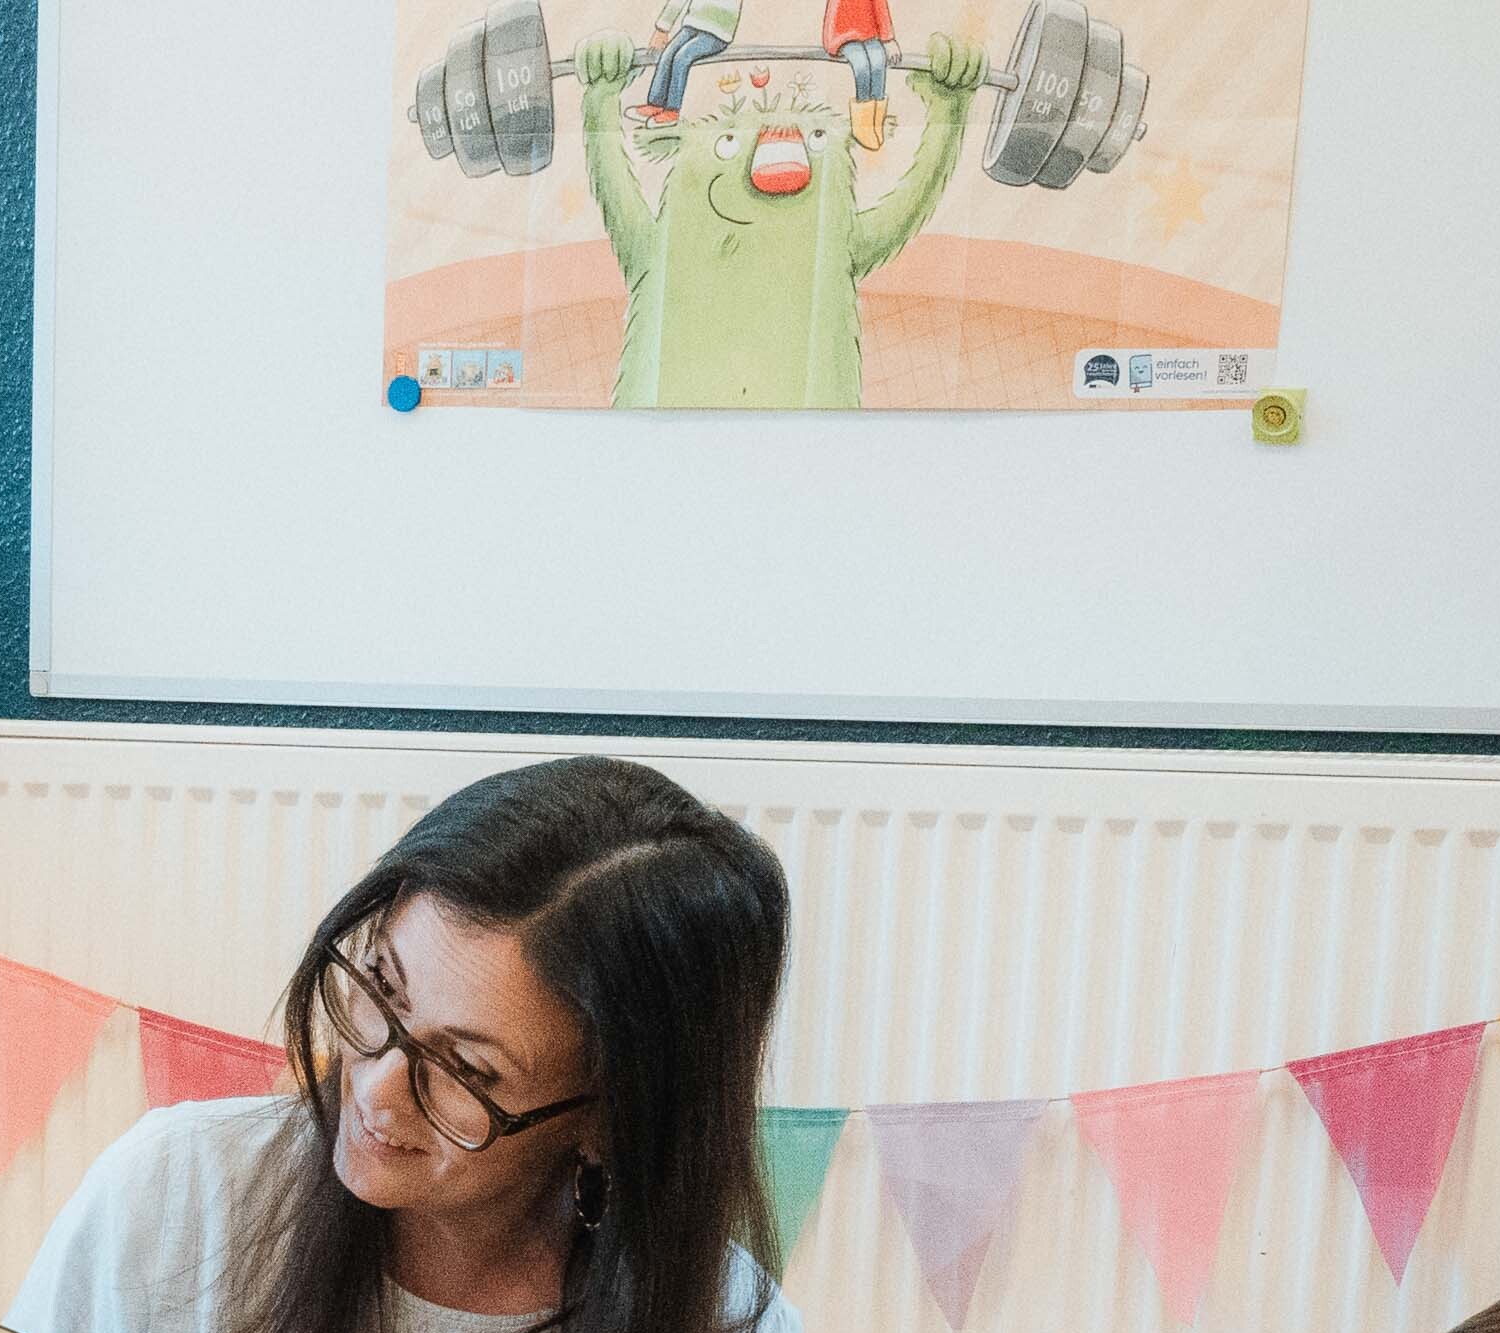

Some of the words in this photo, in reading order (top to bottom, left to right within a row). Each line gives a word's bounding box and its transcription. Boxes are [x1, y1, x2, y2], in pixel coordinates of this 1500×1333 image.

[497, 65, 531, 93] 100
[1035, 70, 1069, 98] 100
[455, 89, 476, 112] 50
[507, 94, 529, 114] ICH
[1031, 99, 1052, 115] ICH
[1080, 91, 1103, 112] 50
[425, 105, 442, 124] 10
[460, 112, 480, 130] ICH
[1156, 358, 1199, 369] einfach
[1155, 370, 1207, 380] vorlesen!
